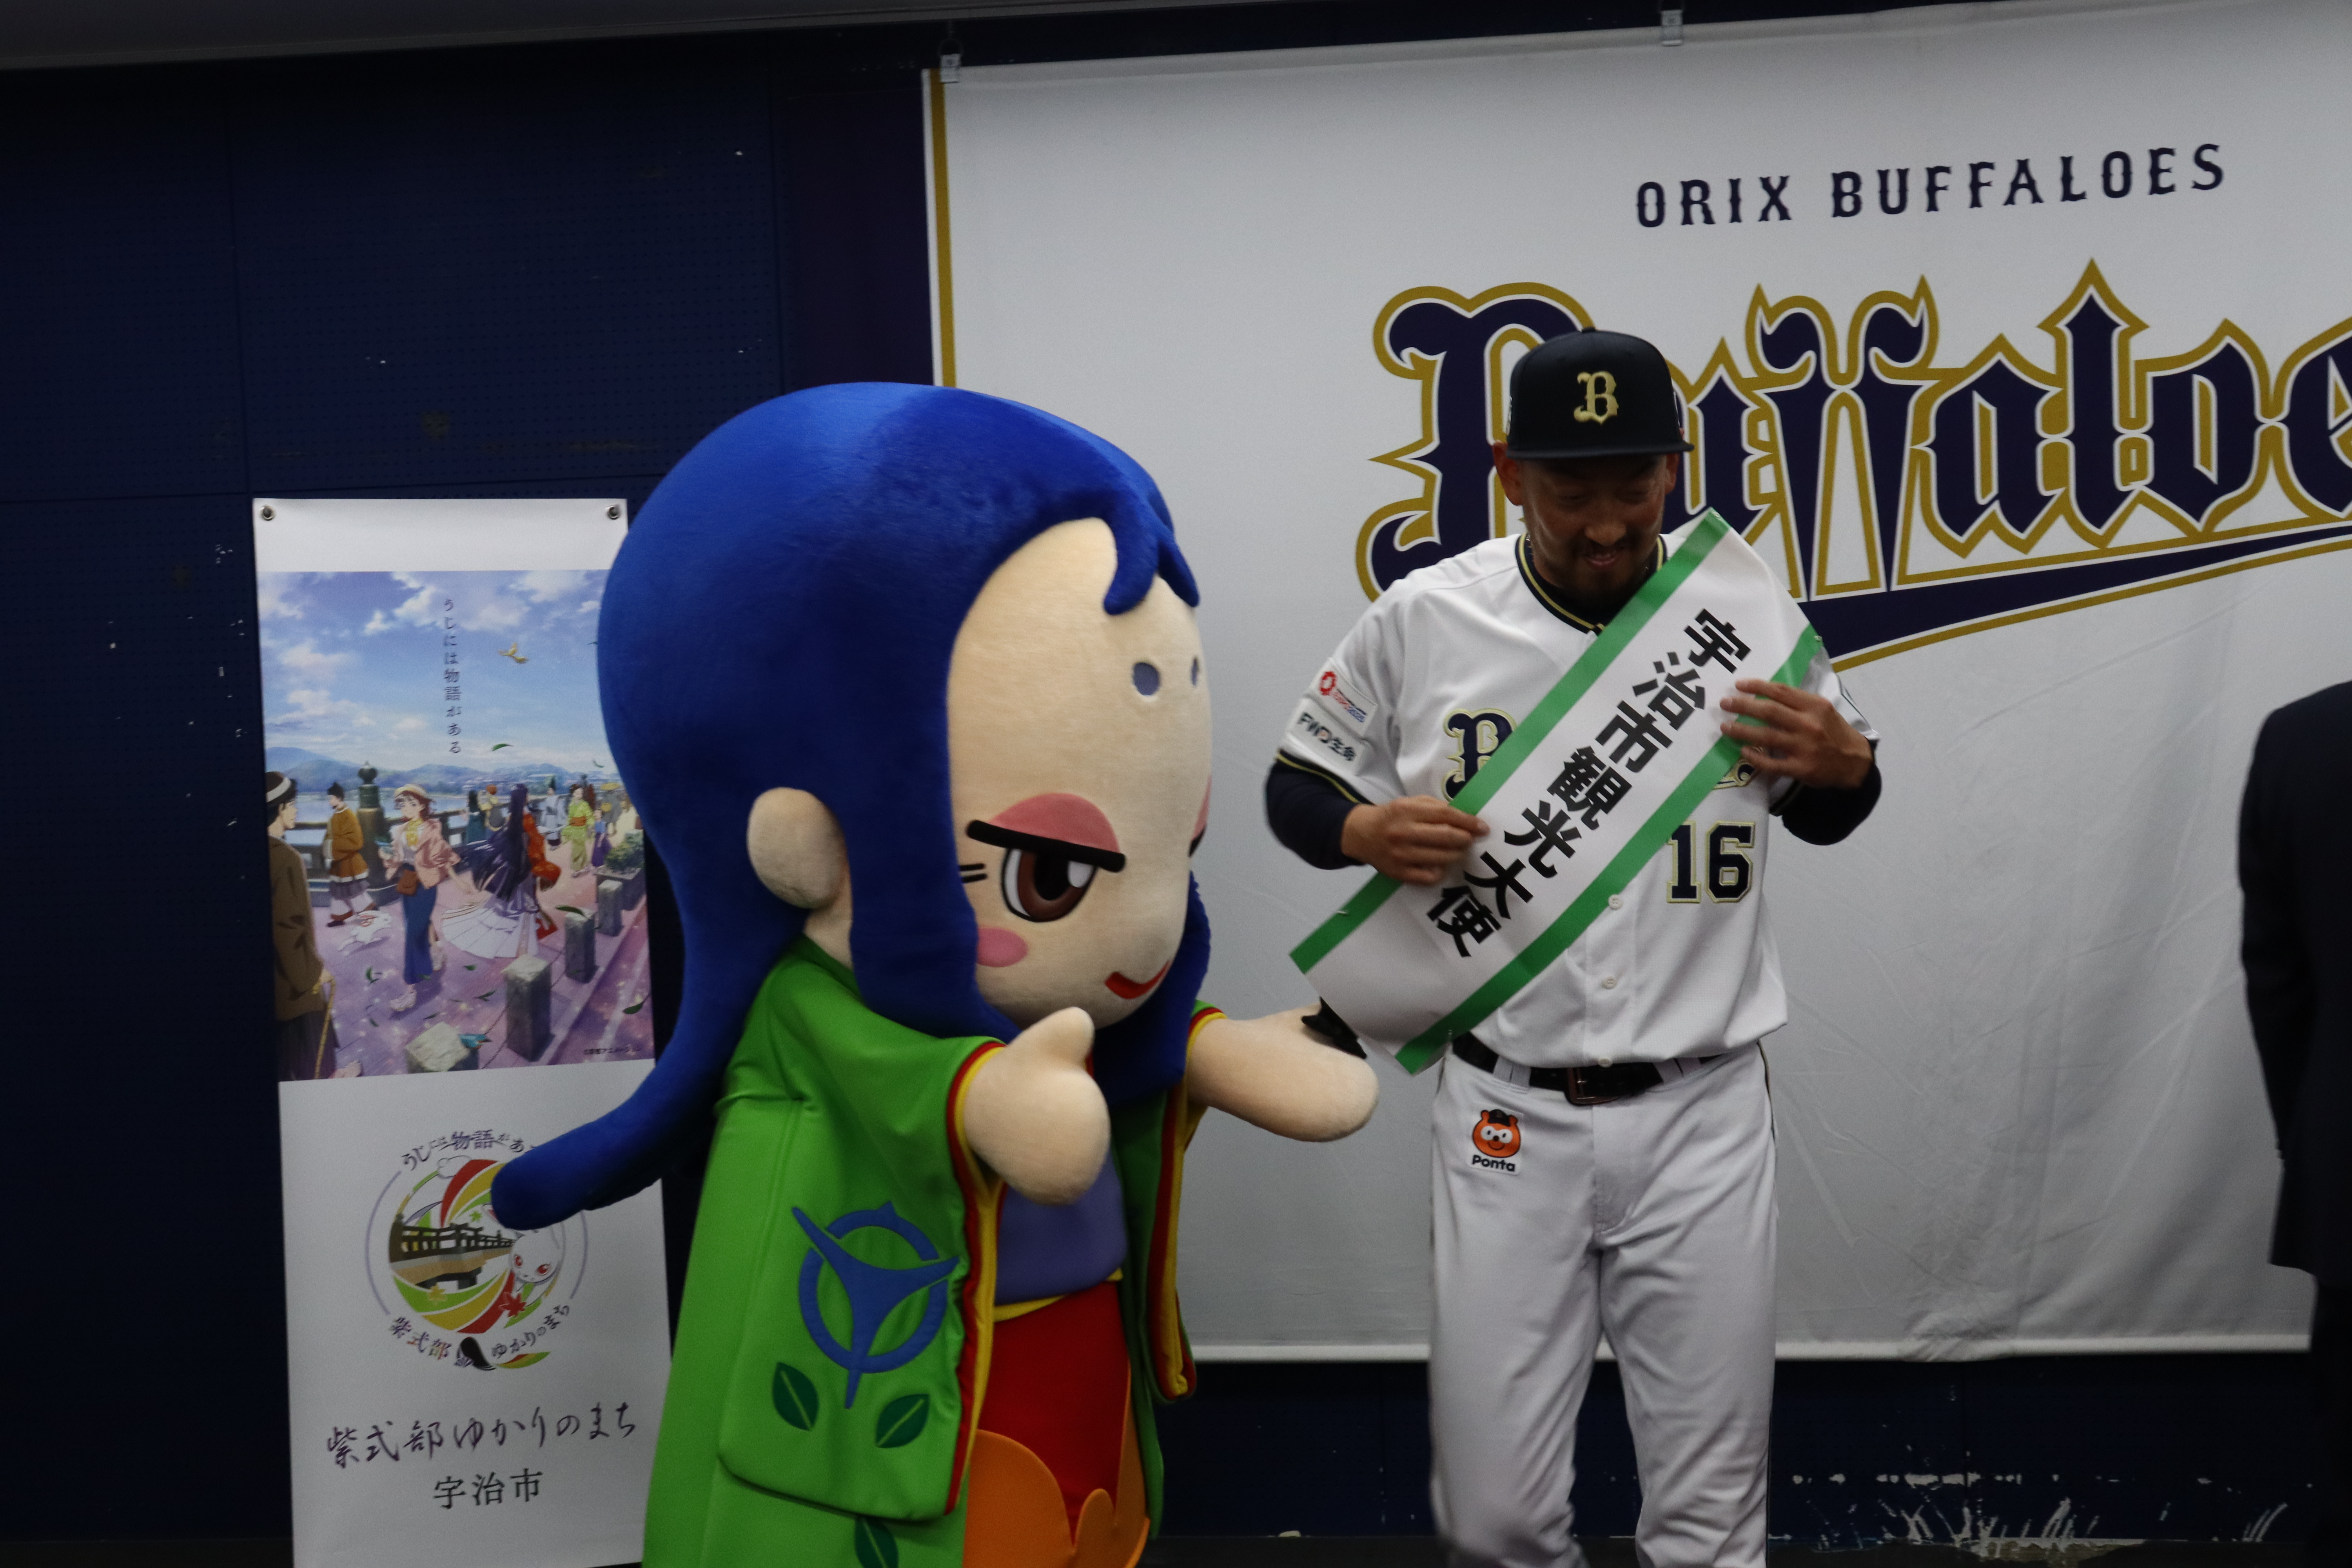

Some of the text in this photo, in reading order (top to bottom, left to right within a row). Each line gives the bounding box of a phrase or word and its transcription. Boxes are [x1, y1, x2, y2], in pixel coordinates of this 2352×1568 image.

[1636, 143, 2224, 228] ORIX BUFFALOES
[1573, 371, 1619, 425] B
[443, 598, 462, 754] うじには物語がある
[1425, 608, 1752, 958] 宇治市観光大使
[1666, 820, 1756, 904] 16
[401, 1129, 540, 1171] うじには物語があ
[1472, 1154, 1515, 1172] Ponta
[327, 1402, 636, 1468] 紫式部ゆかりのまち
[433, 1468, 544, 1509] 宇治市
